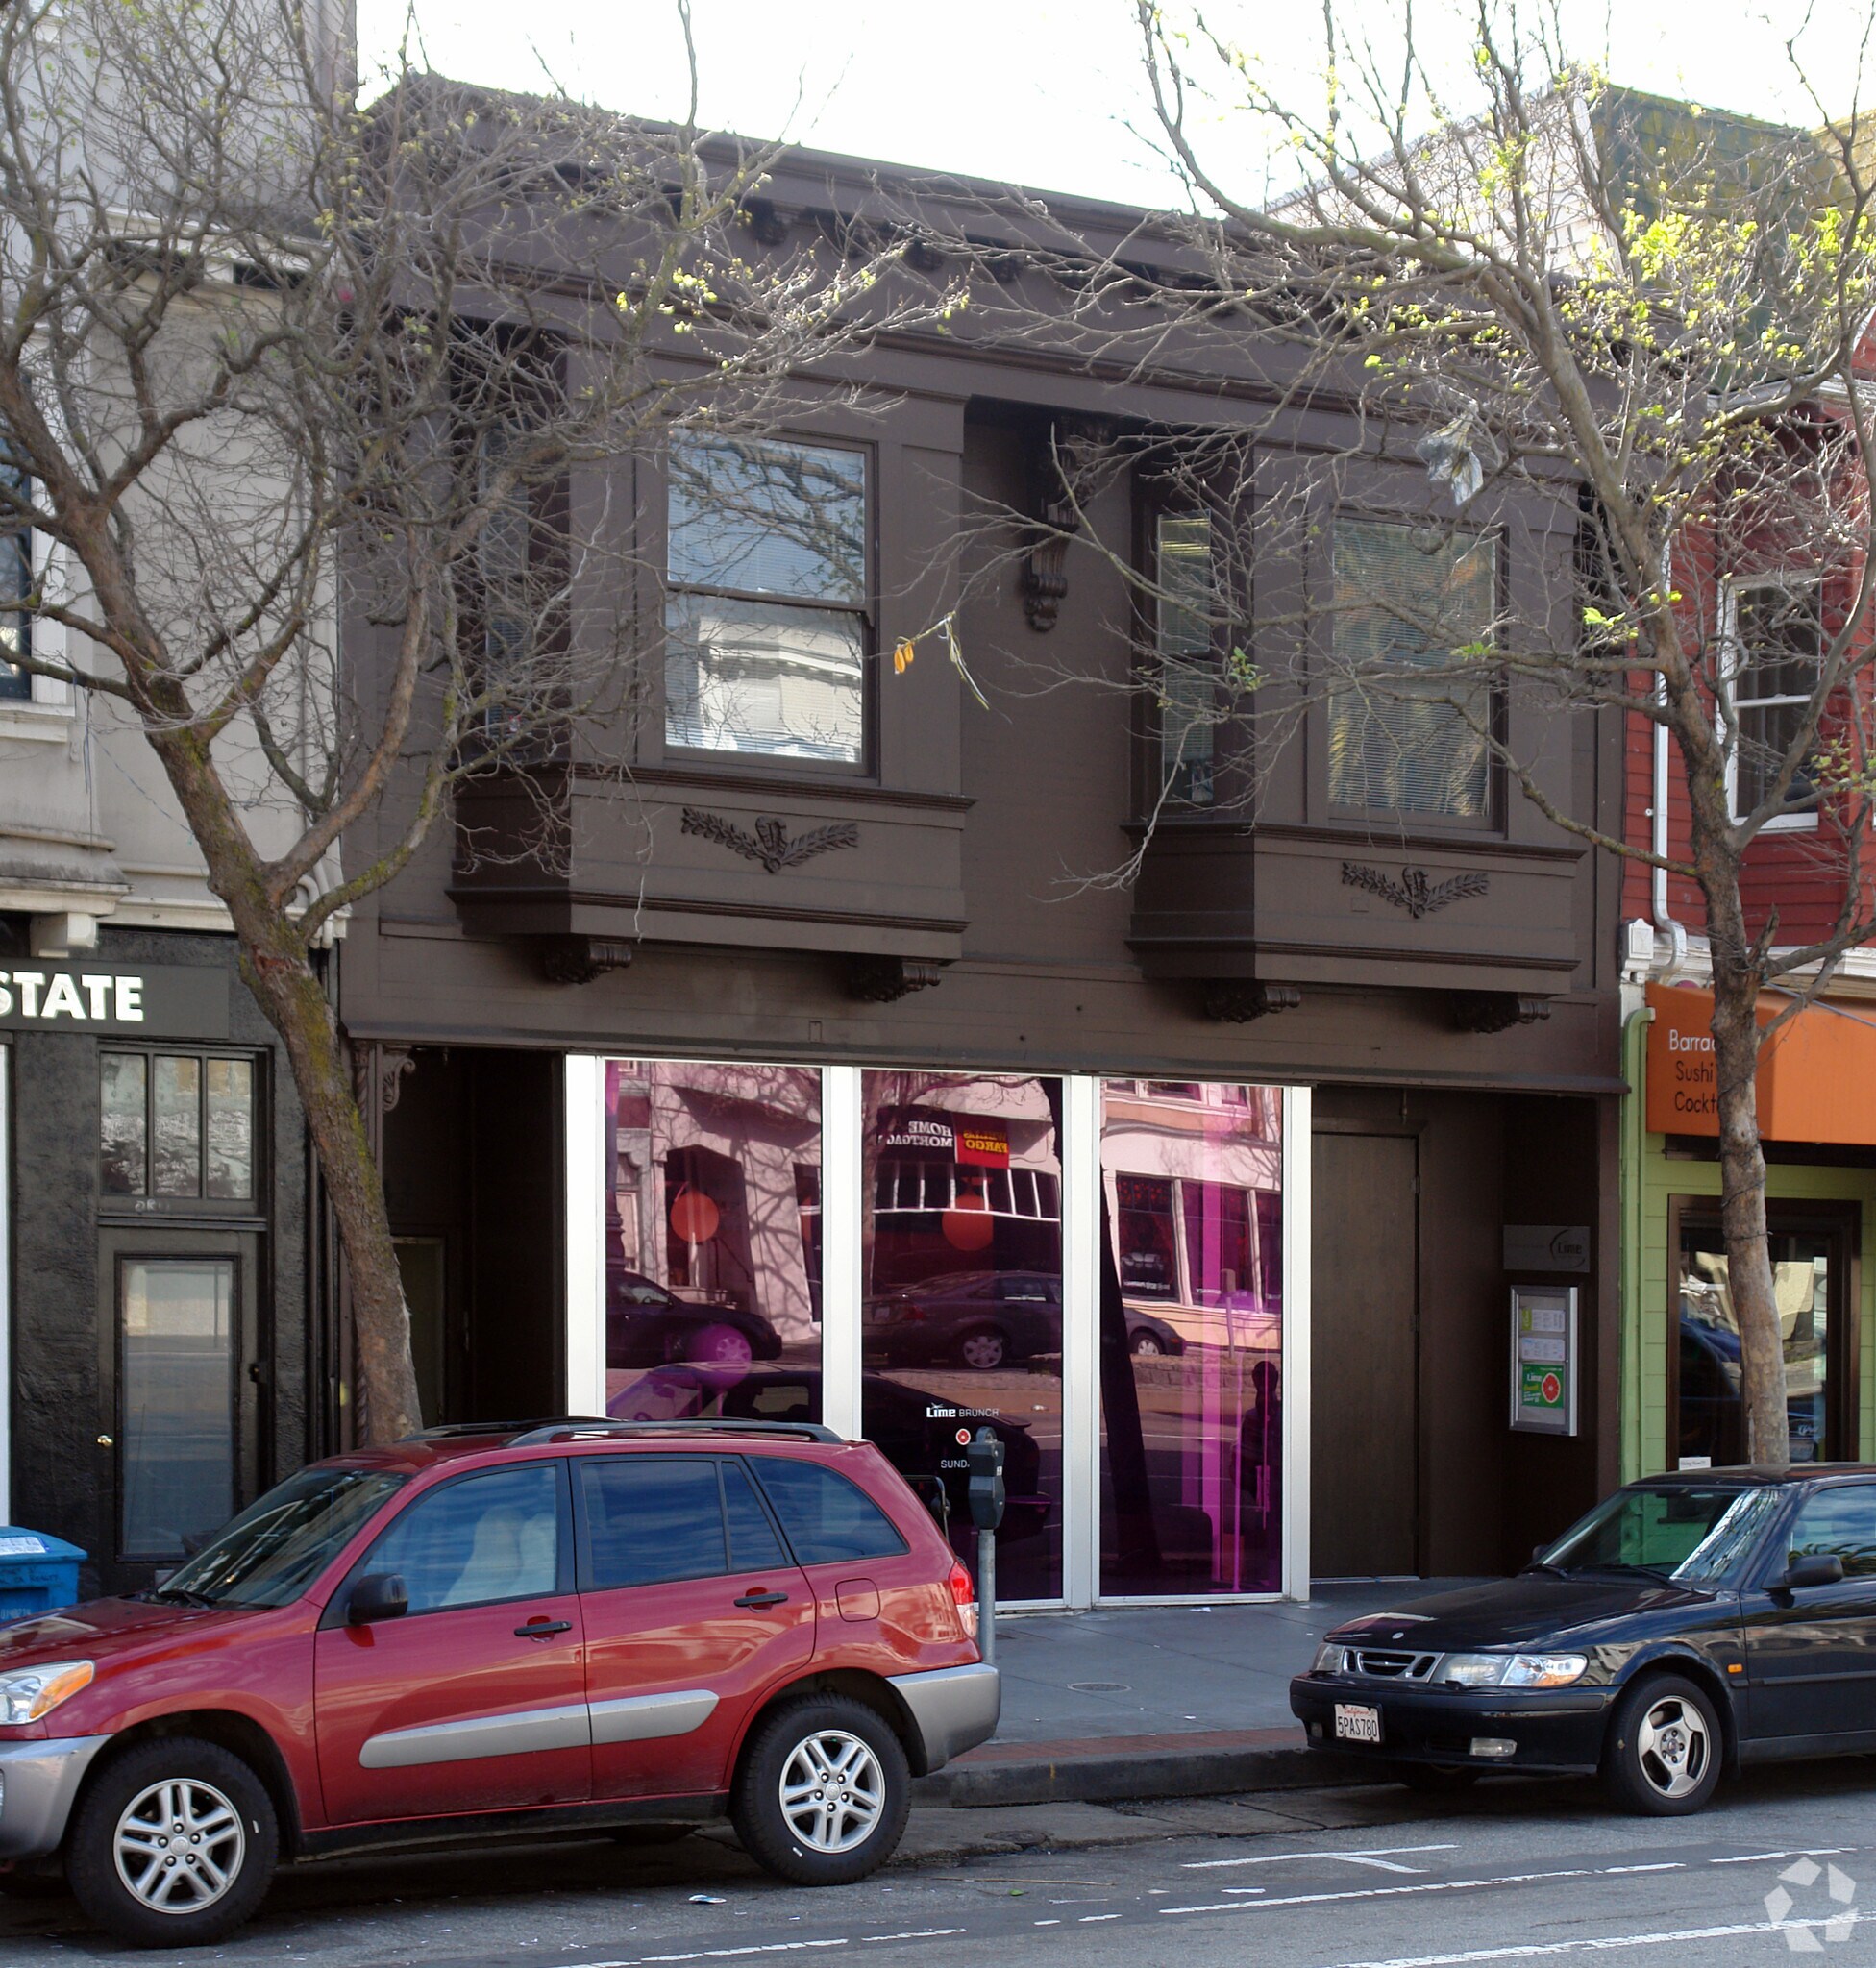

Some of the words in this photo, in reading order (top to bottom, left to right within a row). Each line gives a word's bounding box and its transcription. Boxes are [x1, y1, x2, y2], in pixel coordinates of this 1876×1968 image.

[1675, 1060, 1714, 1082] Sushi
[926, 1405, 956, 1417] Lime
[959, 1409, 999, 1417] BRUNCH
[941, 1460, 970, 1468] SUND
[1337, 1716, 1377, 1737] 5PAS780
